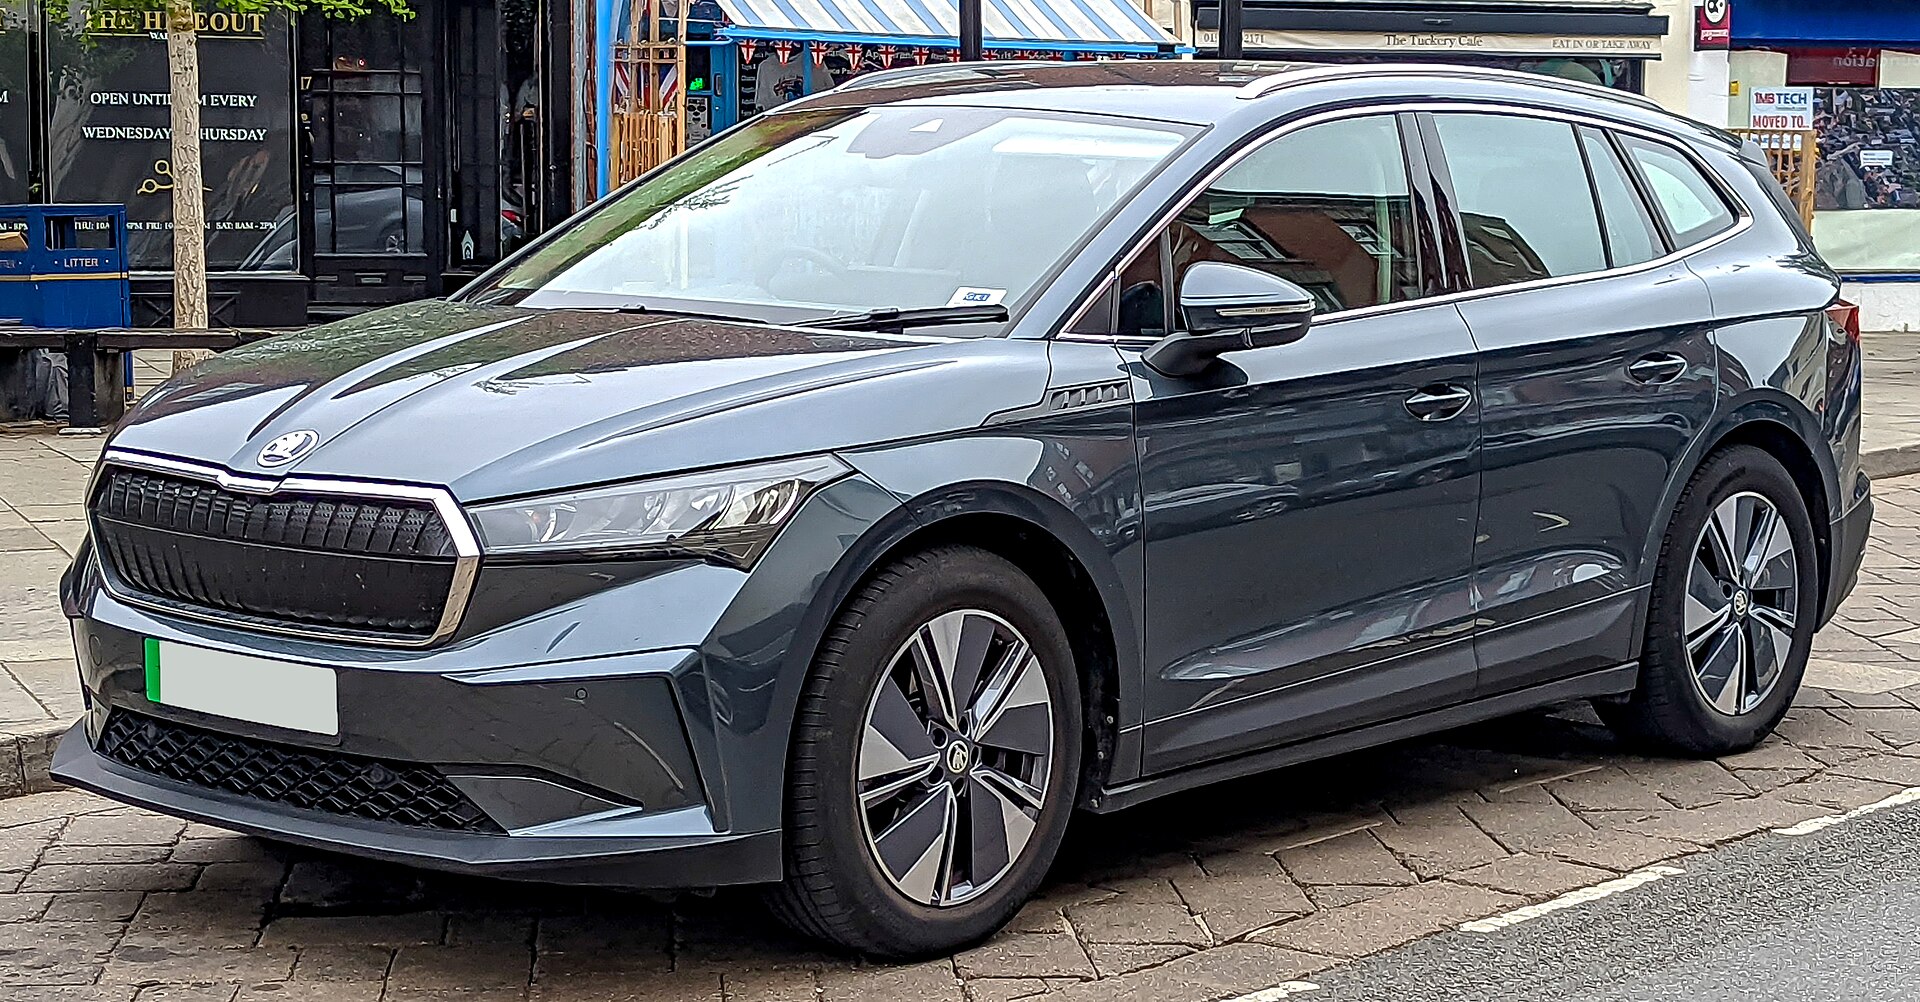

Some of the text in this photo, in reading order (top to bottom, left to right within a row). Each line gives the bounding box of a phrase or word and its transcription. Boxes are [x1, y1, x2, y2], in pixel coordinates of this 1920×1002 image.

[143, 10, 265, 32] HEOUT
[1384, 34, 1483, 47] The Tuckery Cafe
[1552, 40, 1652, 49] EAT IN OR TAKE AWAY
[300, 76, 312, 90] 17
[90, 92, 130, 105] OPEN
[210, 95, 258, 108] EVERY
[1775, 92, 1807, 104] TECH
[1752, 115, 1788, 128] MOVED
[82, 126, 268, 142] WEDNESDAY HURSDAY
[64, 257, 98, 268] LITTER
